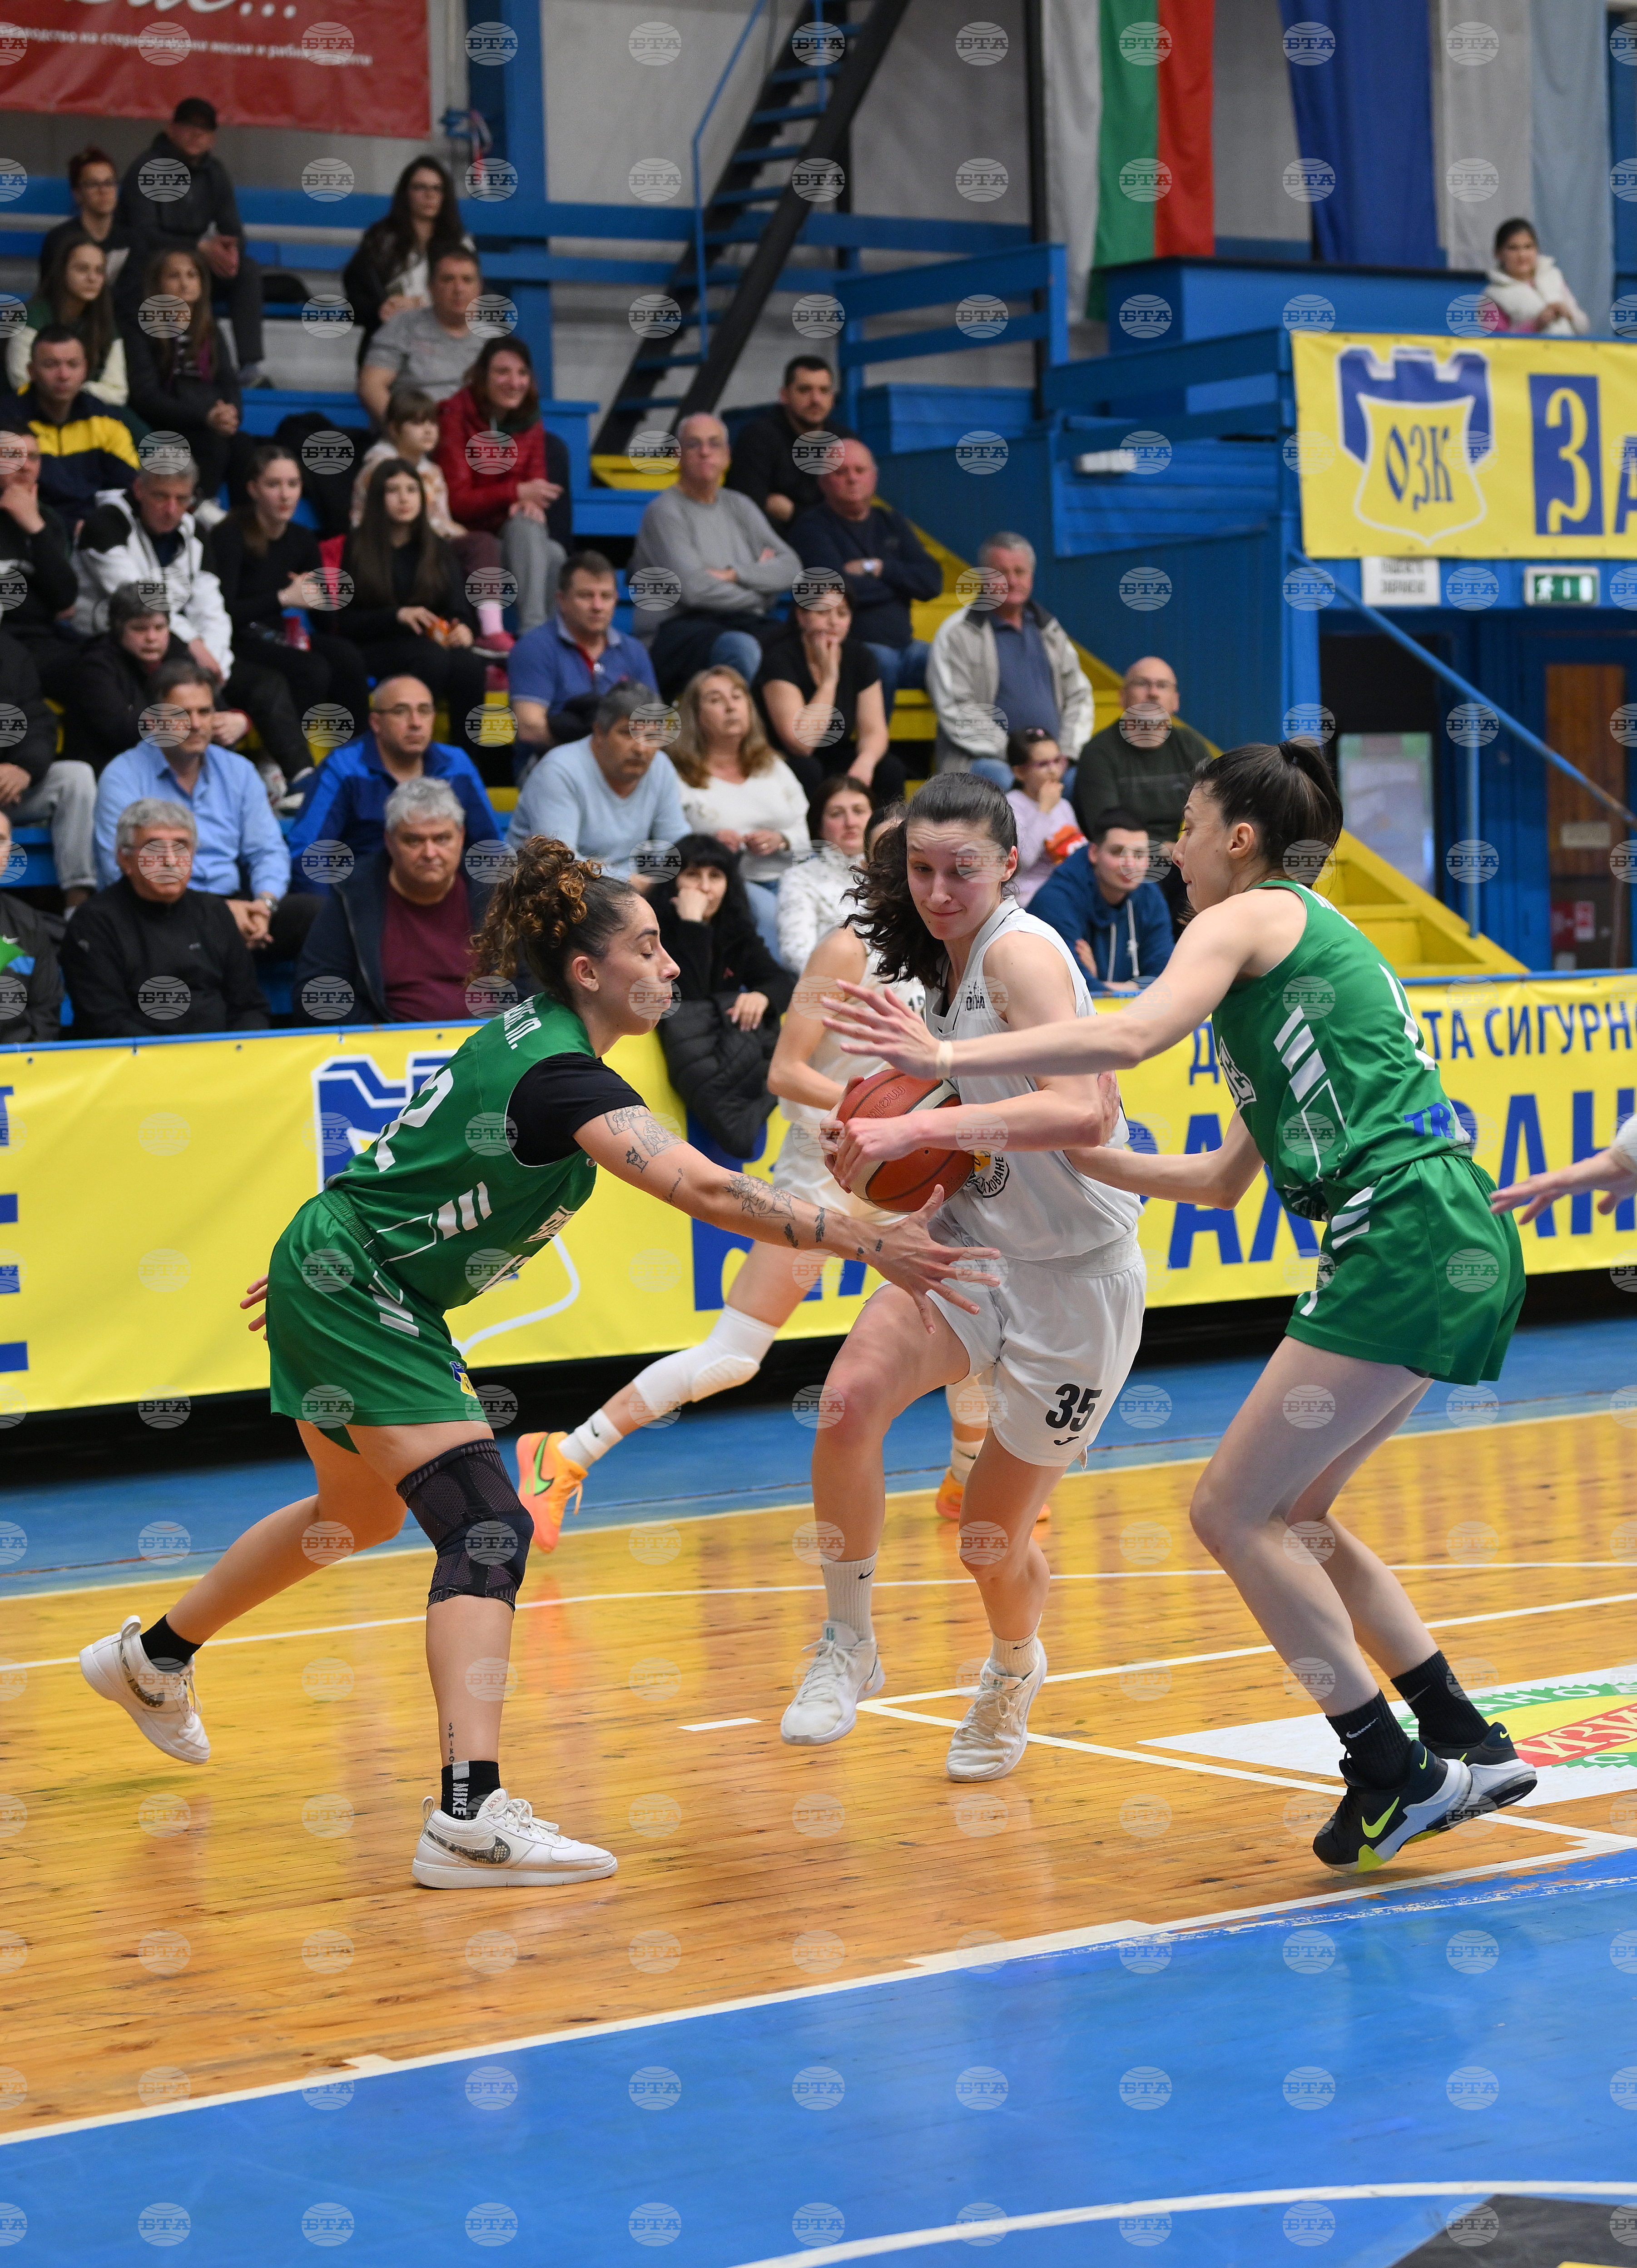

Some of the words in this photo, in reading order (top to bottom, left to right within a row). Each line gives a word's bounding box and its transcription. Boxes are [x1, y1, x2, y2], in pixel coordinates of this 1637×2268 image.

[1384, 423, 1453, 512] ФЗК
[1483, 1002, 1637, 1057] СИГУРН
[1046, 1383, 1103, 1432] 35
[452, 1782, 469, 1816] NIKE
[487, 1794, 503, 1810] BOOK
